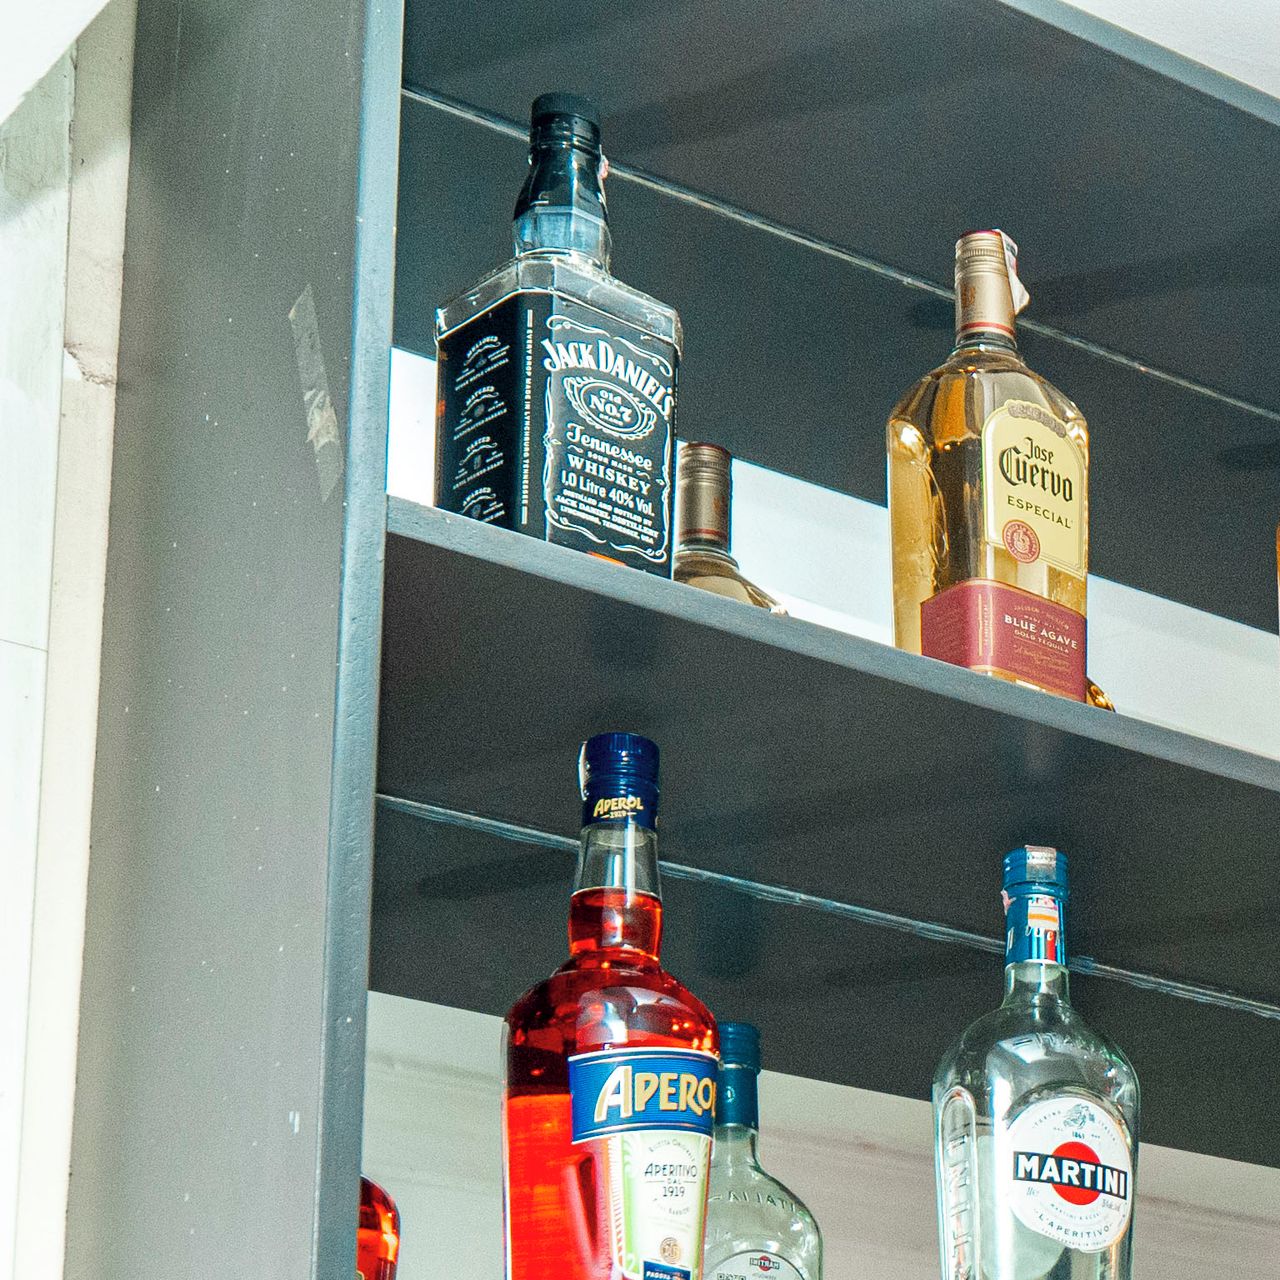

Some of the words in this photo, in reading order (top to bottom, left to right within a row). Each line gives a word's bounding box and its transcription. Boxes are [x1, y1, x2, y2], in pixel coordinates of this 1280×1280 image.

[526, 329, 534, 355] EVERY
[526, 355, 534, 377] DROP
[540, 338, 600, 371] JACK
[598, 339, 675, 420] DANIEL'S
[525, 377, 533, 400] MADE
[525, 401, 532, 410] IN
[566, 422, 653, 471] Tennessee
[566, 453, 652, 496] WHISKEY
[998, 446, 1074, 502] Cuervo
[579, 475, 607, 499] Litre
[608, 487, 636, 509] 40%
[636, 496, 656, 518] Vol.
[1006, 494, 1072, 529] ESPECIAL
[1003, 613, 1037, 633] BLUE
[1040, 627, 1078, 649] AGAVE
[593, 796, 645, 818] APEROL
[644, 1162, 698, 1178] APERITIVO
[1017, 1154, 1128, 1197] MARTINI
[661, 1185, 686, 1198] 1919
[1038, 1212, 1111, 1239] L'APERITIVO
